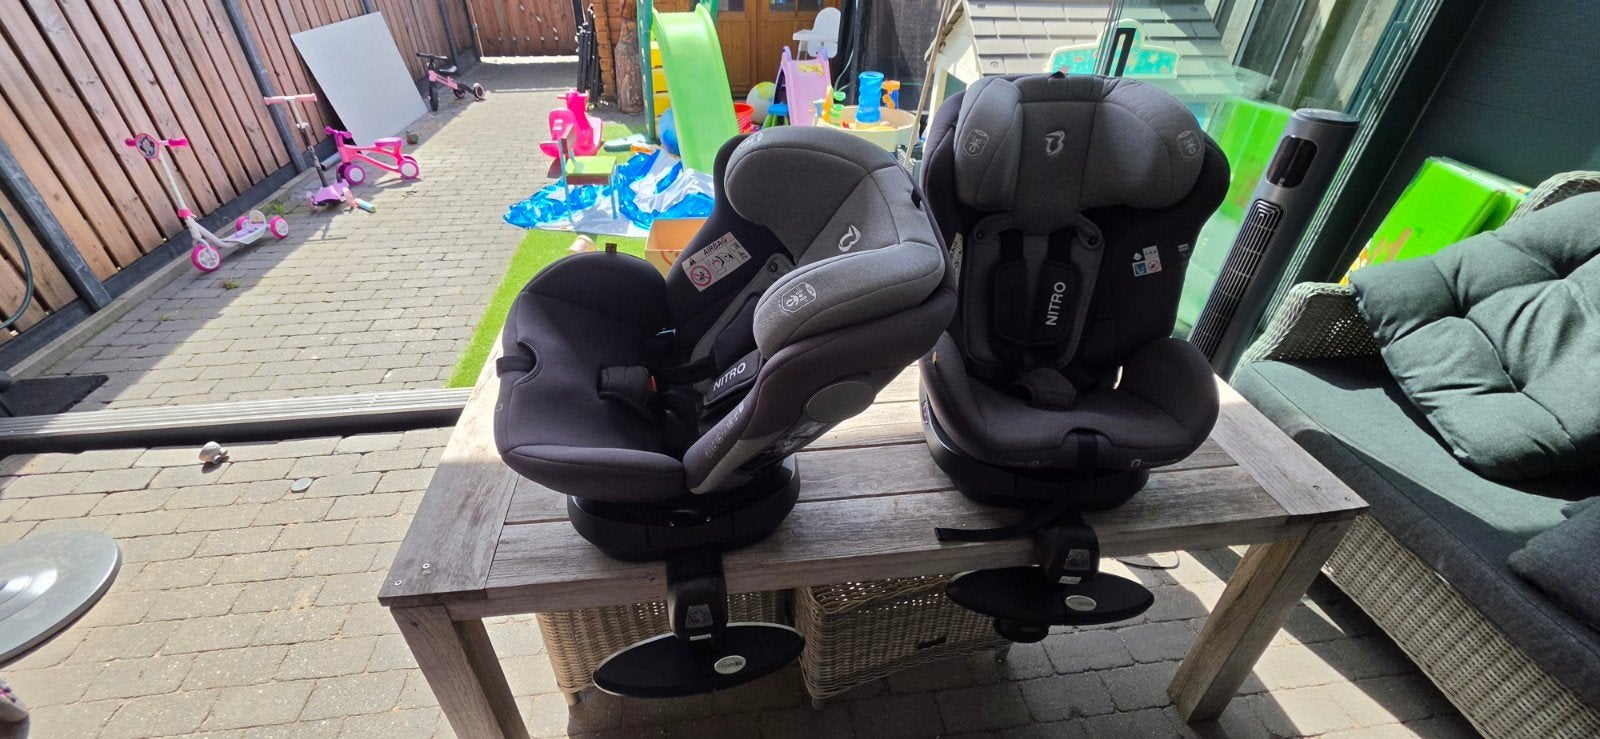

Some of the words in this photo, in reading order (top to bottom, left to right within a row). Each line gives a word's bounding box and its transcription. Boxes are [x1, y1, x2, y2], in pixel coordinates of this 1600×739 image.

[703, 237, 728, 256] AIRBAG
[1045, 281, 1066, 326] NITRO
[713, 362, 746, 391] NITRO
